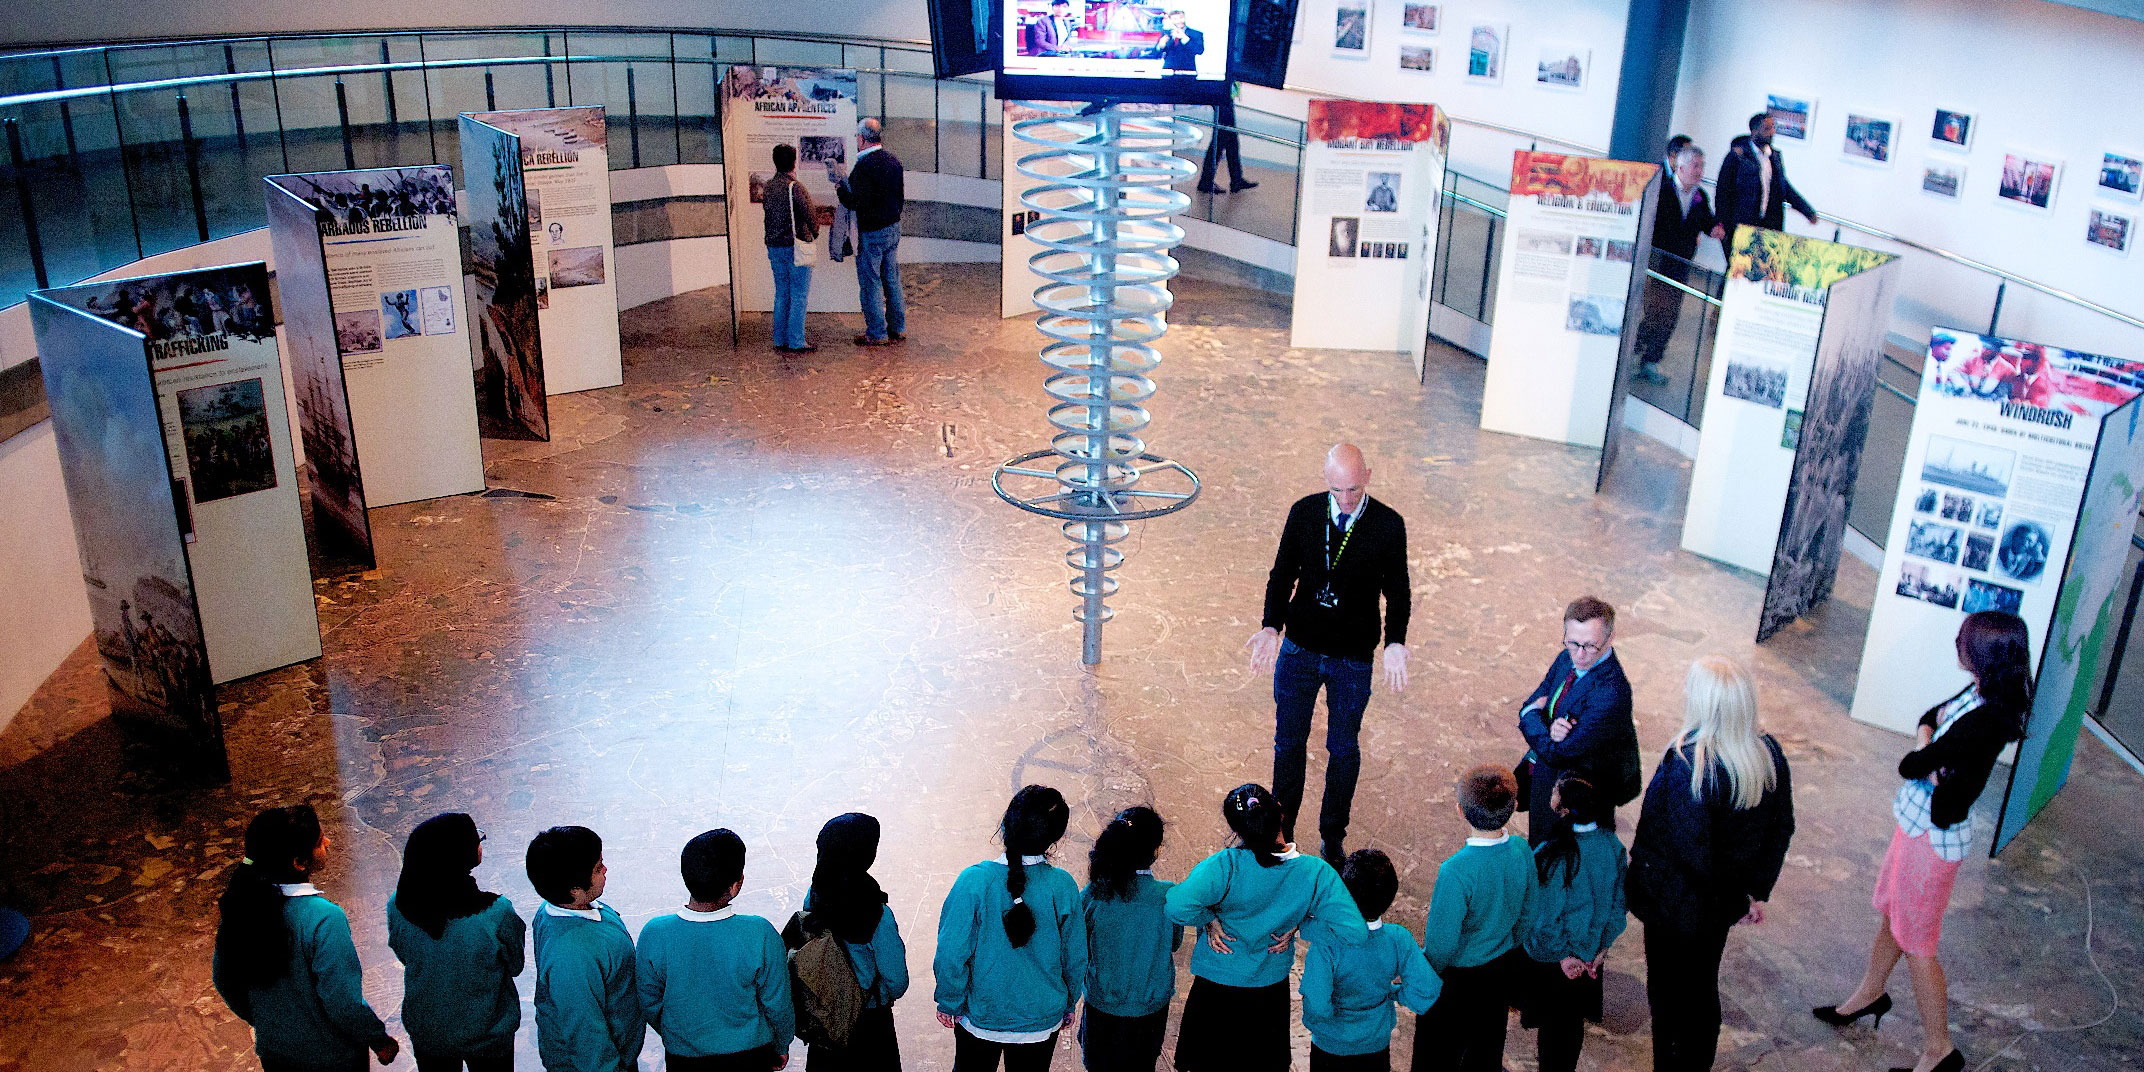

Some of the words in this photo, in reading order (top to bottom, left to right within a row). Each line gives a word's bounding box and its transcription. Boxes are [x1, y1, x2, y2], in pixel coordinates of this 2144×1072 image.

[754, 101, 786, 113] AFRICAN
[537, 150, 579, 165] REBELLION
[320, 220, 370, 237] ARBADOS
[373, 215, 428, 233] REBELLION
[2000, 400, 2073, 430] WINDRUSH
[2074, 441, 2095, 453] BRITAI
